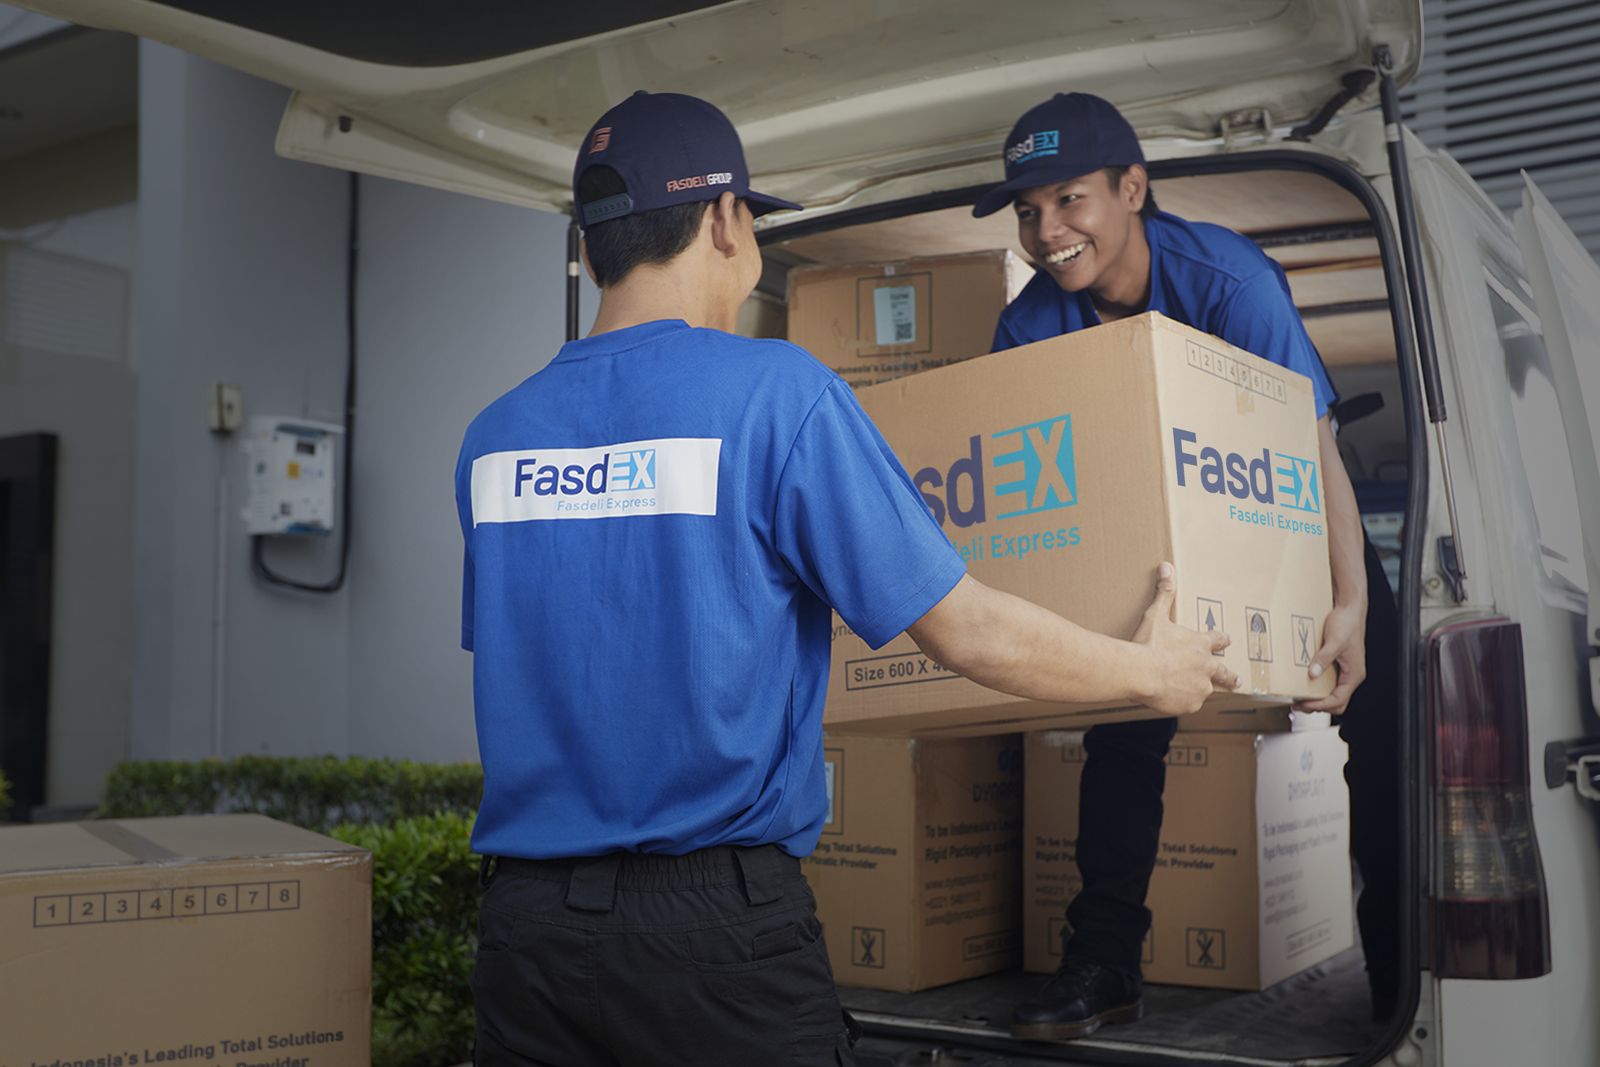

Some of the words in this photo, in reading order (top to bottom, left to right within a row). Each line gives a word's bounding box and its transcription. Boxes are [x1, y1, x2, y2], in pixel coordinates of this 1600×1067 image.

[666, 176, 707, 192] FASDELI
[707, 172, 733, 185] GROUP
[514, 448, 656, 498] FasdEX
[1172, 427, 1320, 514] FasdEX
[557, 500, 604, 512] Fasdeli
[606, 497, 656, 511] Express
[1229, 505, 1275, 527] Fasdeli
[1277, 514, 1323, 536] Express
[990, 526, 1082, 561] Express
[854, 666, 885, 683] Size
[889, 660, 915, 678] 600
[918, 659, 928, 675] X
[47, 903, 56, 918] 1
[82, 902, 94, 916] 2
[116, 900, 128, 914] 3
[150, 897, 162, 911] 4
[184, 895, 195, 909] 5
[216, 893, 228, 906] 6
[248, 891, 259, 904] 7
[279, 889, 290, 903] 8
[144, 1044, 215, 1061] Leading
[220, 1036, 262, 1054] Total
[267, 1030, 345, 1049] Solutions
